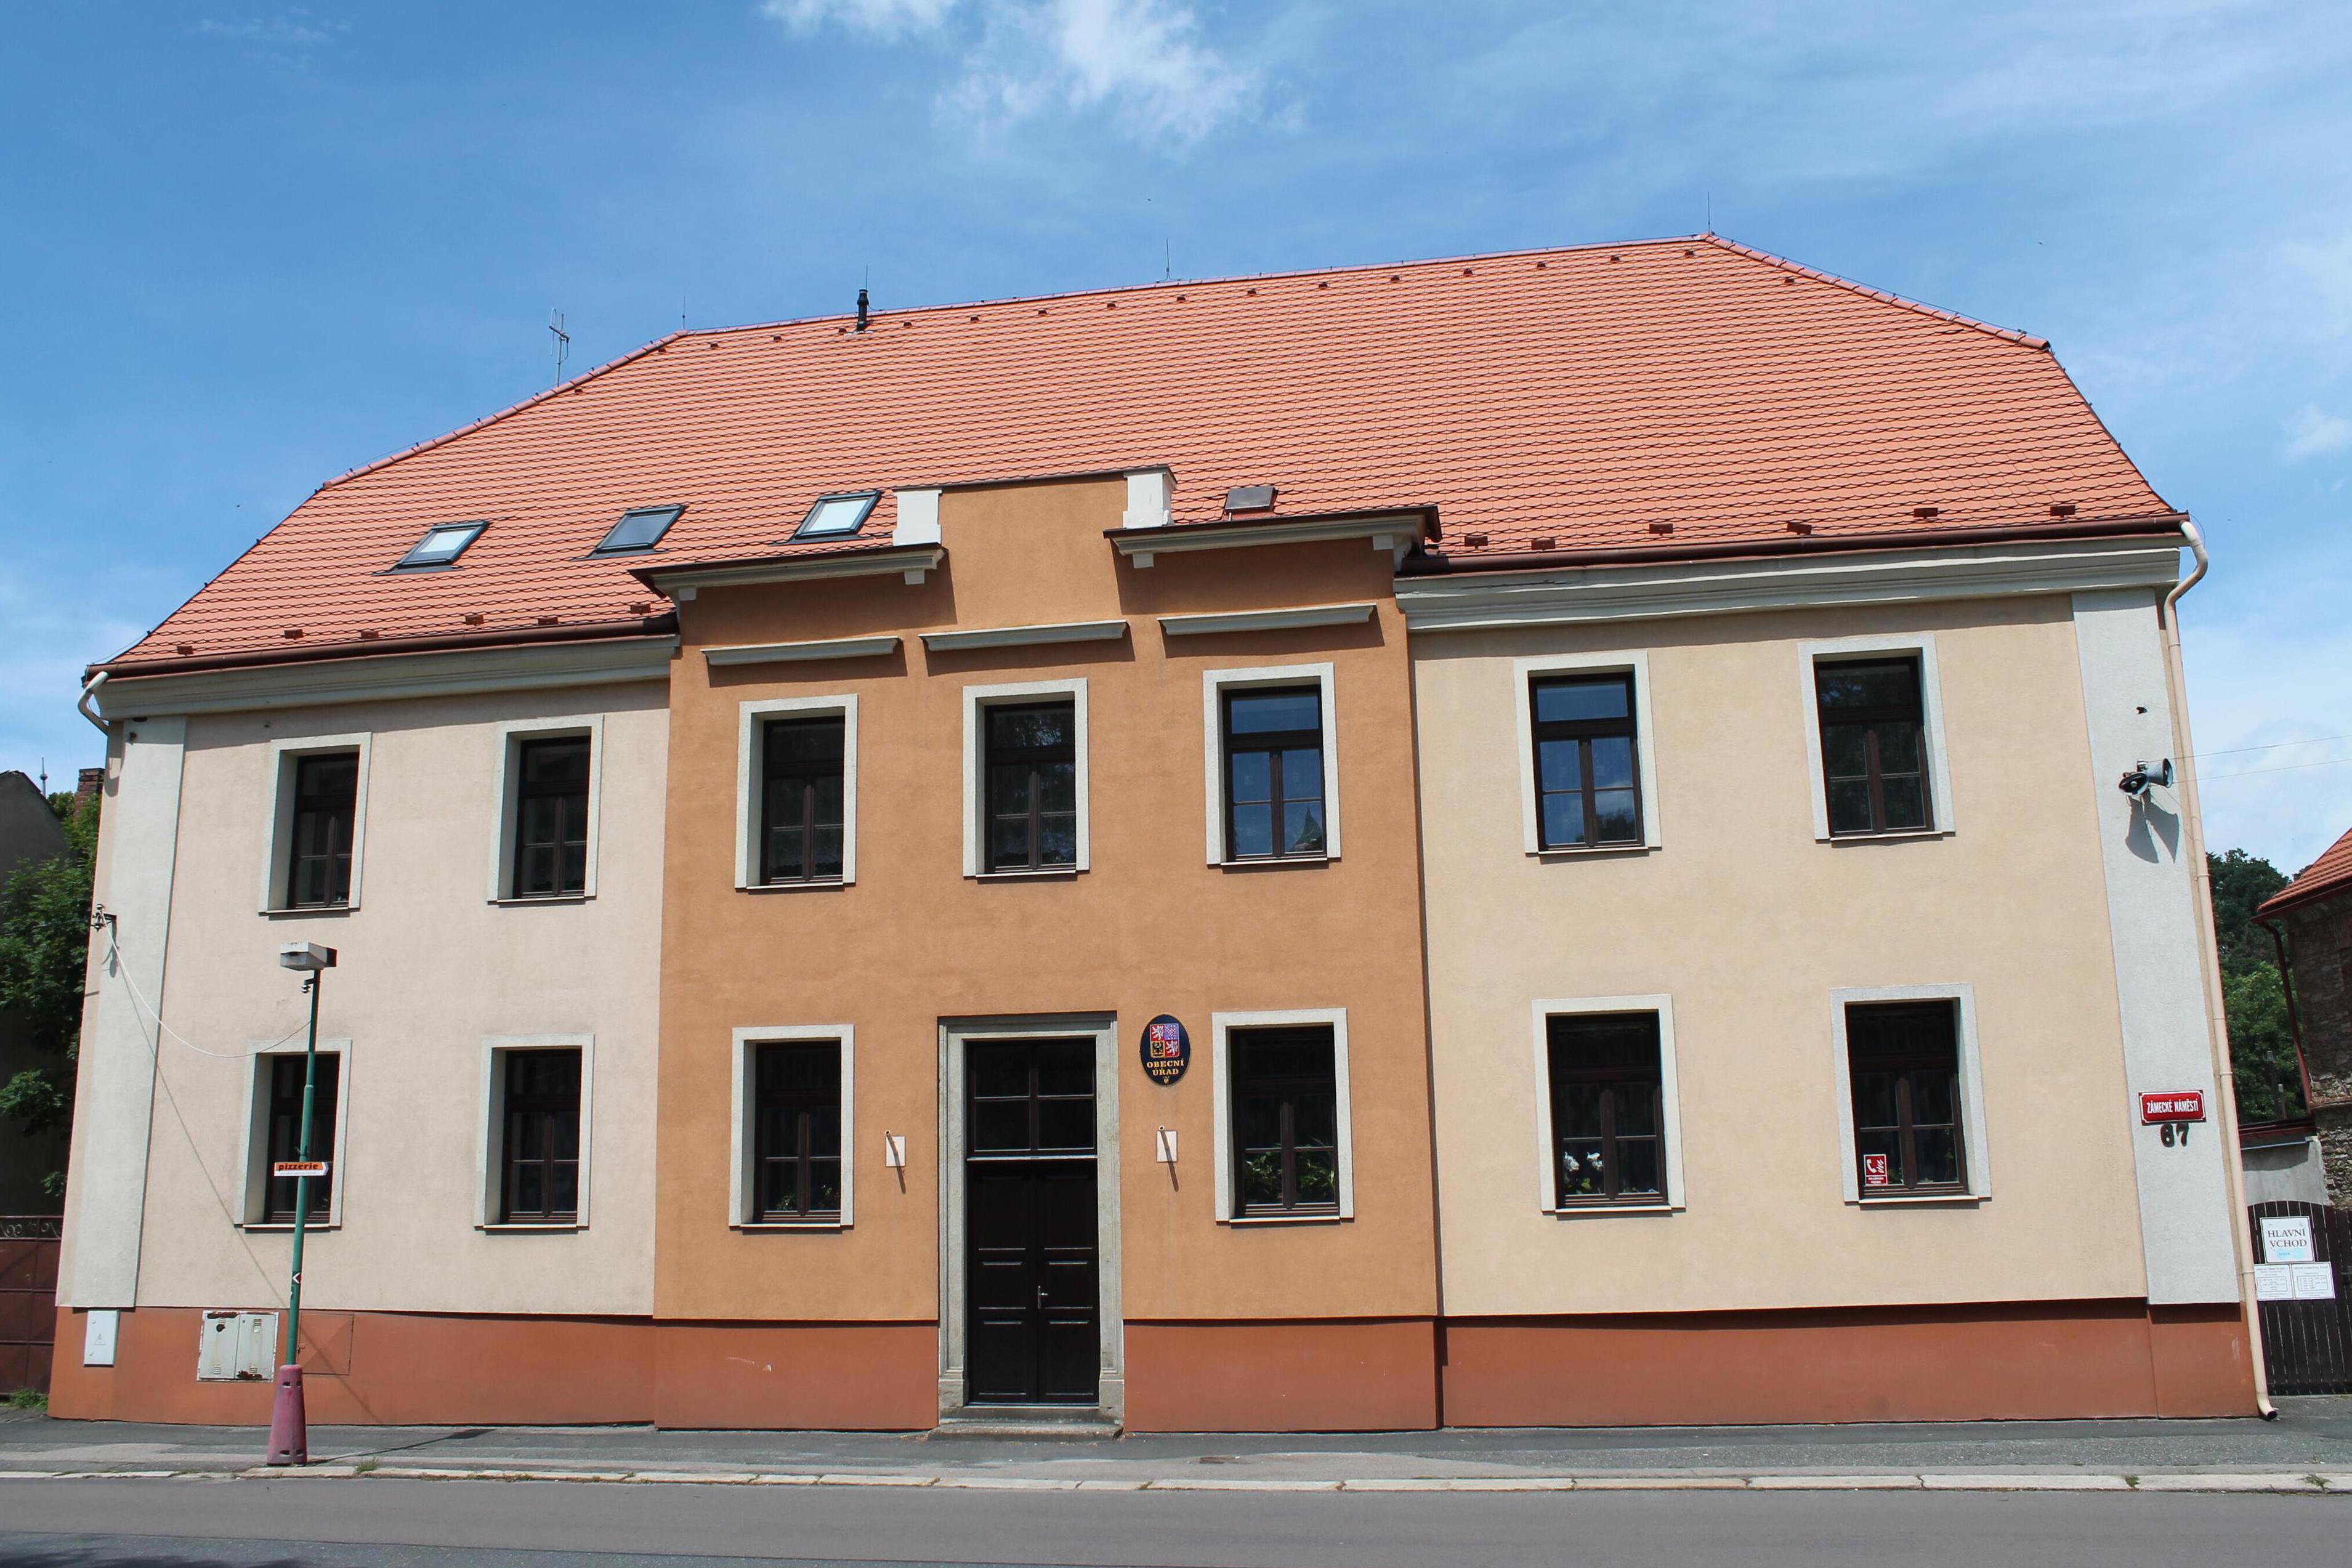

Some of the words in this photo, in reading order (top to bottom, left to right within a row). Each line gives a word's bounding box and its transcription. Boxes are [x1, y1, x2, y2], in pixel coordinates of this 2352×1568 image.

[1147, 1058, 1184, 1068] OBECNÍ
[1152, 1067, 1179, 1076] ÚŘAD
[2146, 1099, 2173, 1113] ZÁMECKÉ
[2174, 1098, 2199, 1113] NÁMĚSTÍ
[2160, 1123, 2189, 1147] 87
[279, 1163, 318, 1171] pizzerie
[2268, 1227, 2306, 1238] HLAVNÍ
[2269, 1239, 2307, 1248] VCHOD
